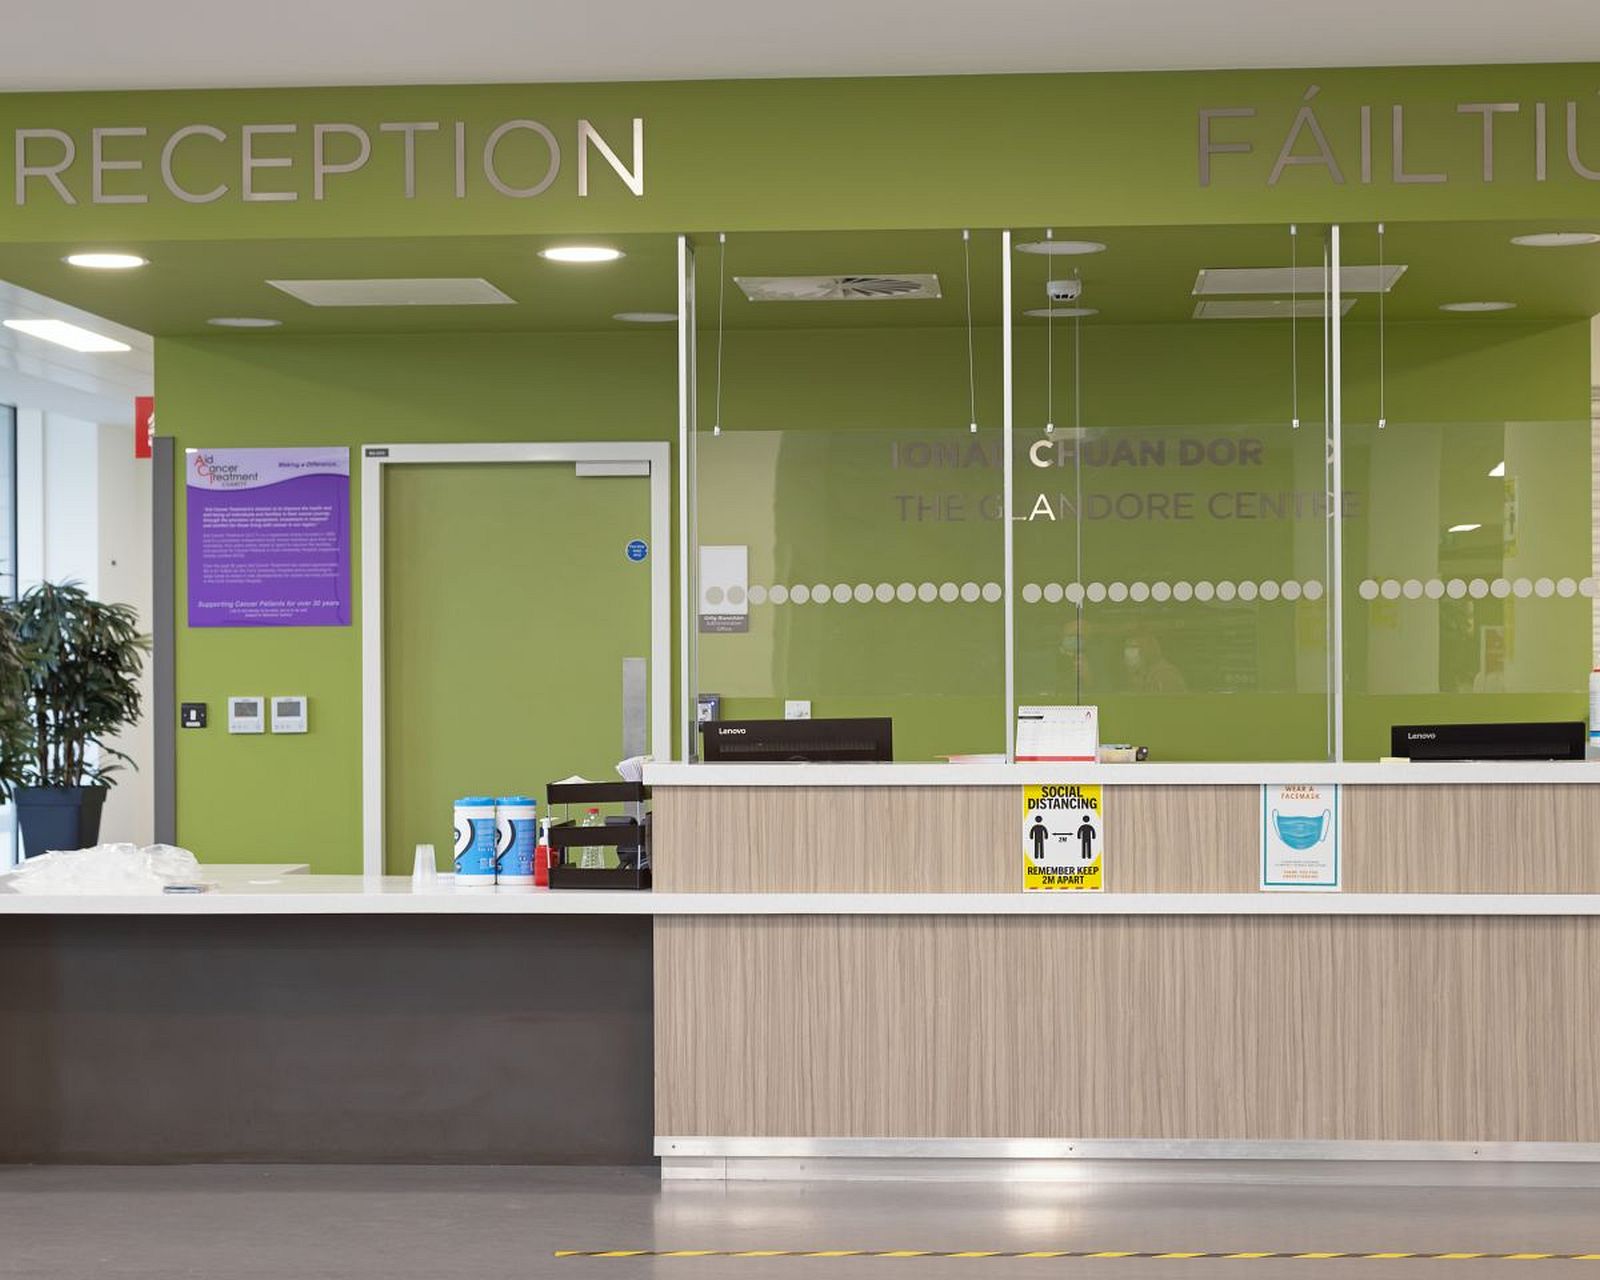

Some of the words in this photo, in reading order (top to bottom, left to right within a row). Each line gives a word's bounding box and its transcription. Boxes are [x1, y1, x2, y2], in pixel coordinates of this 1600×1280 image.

[15, 117, 644, 205] RECEPTION
[1029, 438, 1165, 468] CHUAN
[1179, 438, 1264, 467] DOR
[194, 454, 214, 466] Aid
[197, 463, 239, 477] Cancer
[208, 472, 258, 486] Treatment
[895, 495, 965, 522] THE
[718, 727, 747, 735] Lenovo
[1407, 732, 1437, 740] Lenovo
[1041, 785, 1083, 798] SOCIAL
[1281, 792, 1320, 800] FACEMASK
[1027, 798, 1098, 810] DISTANCING
[1027, 866, 1075, 876] REMEMBER
[1076, 866, 1099, 876] KEEP
[1042, 875, 1055, 885] 2M
[1056, 875, 1085, 885] APART
